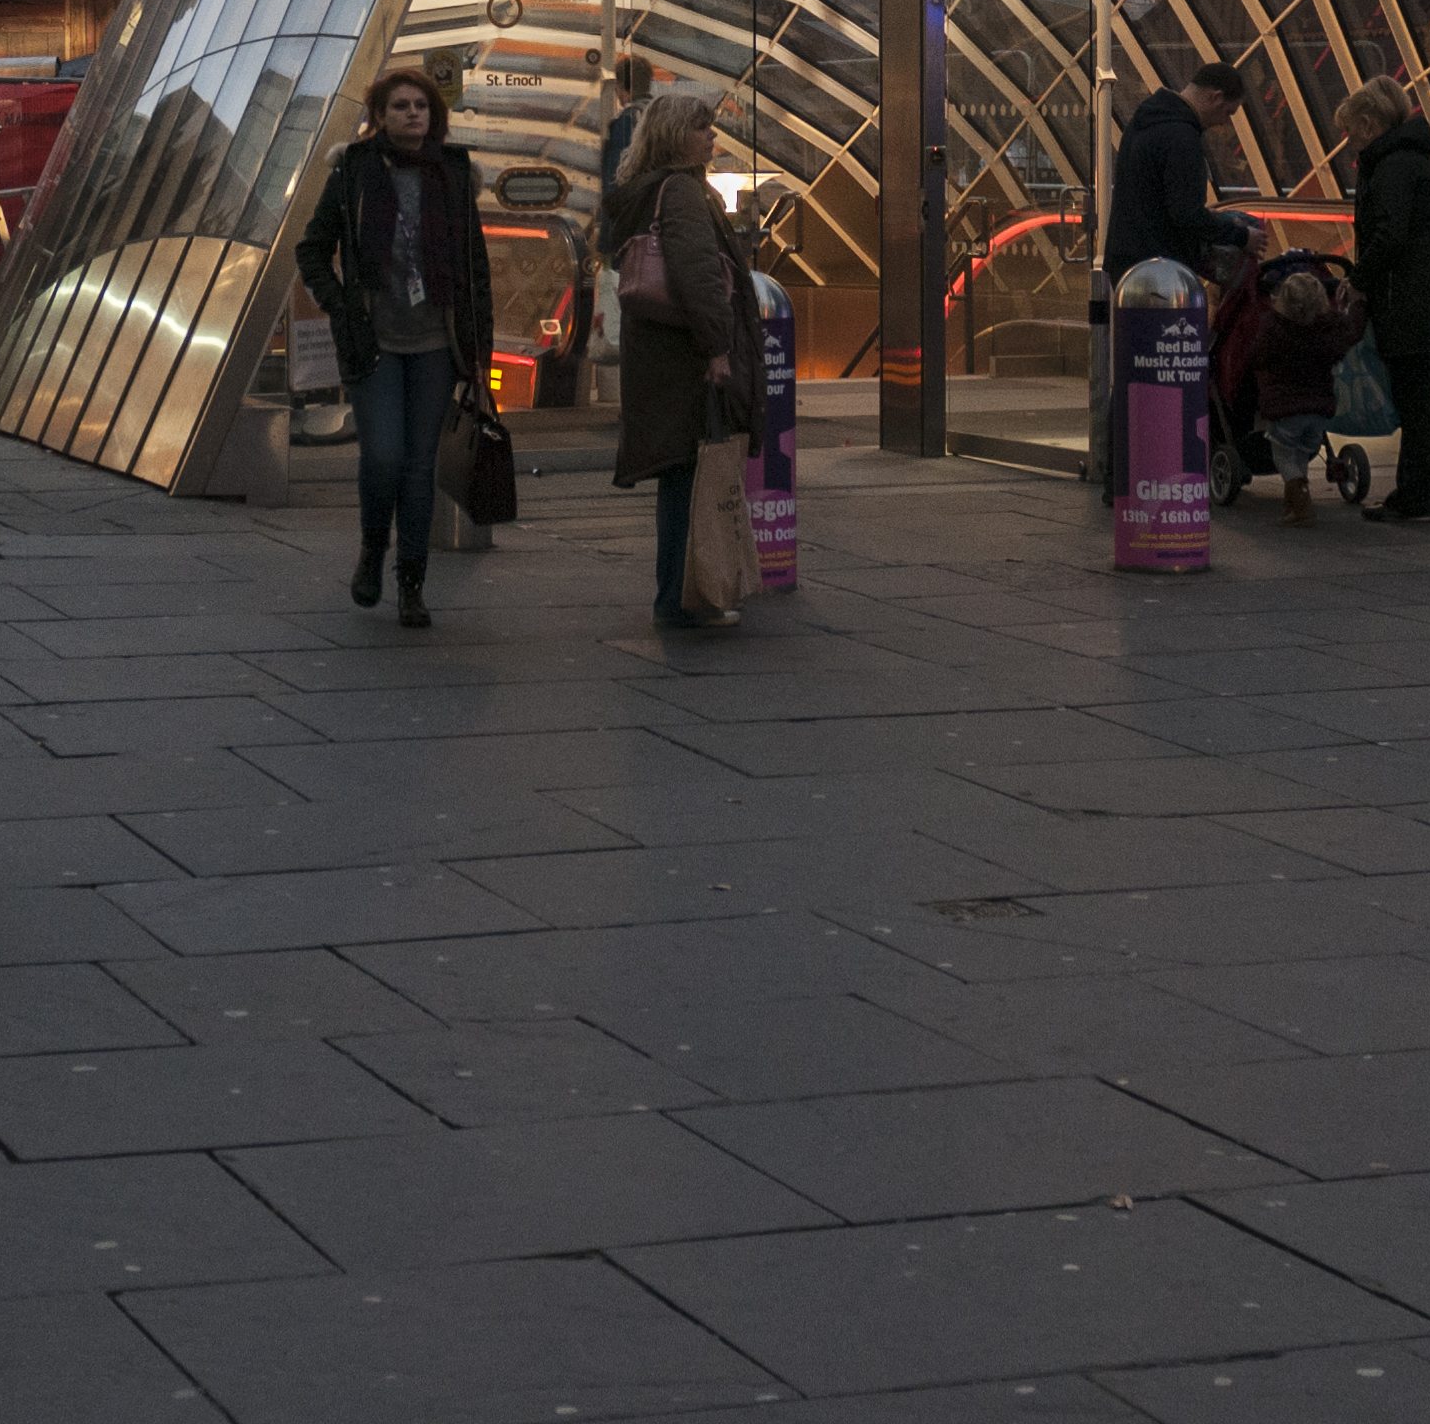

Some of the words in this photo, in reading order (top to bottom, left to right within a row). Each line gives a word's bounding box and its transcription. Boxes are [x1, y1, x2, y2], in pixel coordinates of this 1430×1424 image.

[486, 74, 502, 87] St.
[505, 74, 542, 87] Enoch
[1156, 341, 1180, 353] Red
[764, 352, 785, 365] Bull
[1134, 355, 1169, 368] Music
[1157, 370, 1176, 382] UK
[1177, 370, 1201, 382] Tour
[1122, 510, 1149, 523] 13th
[1161, 510, 1191, 524] 16th
